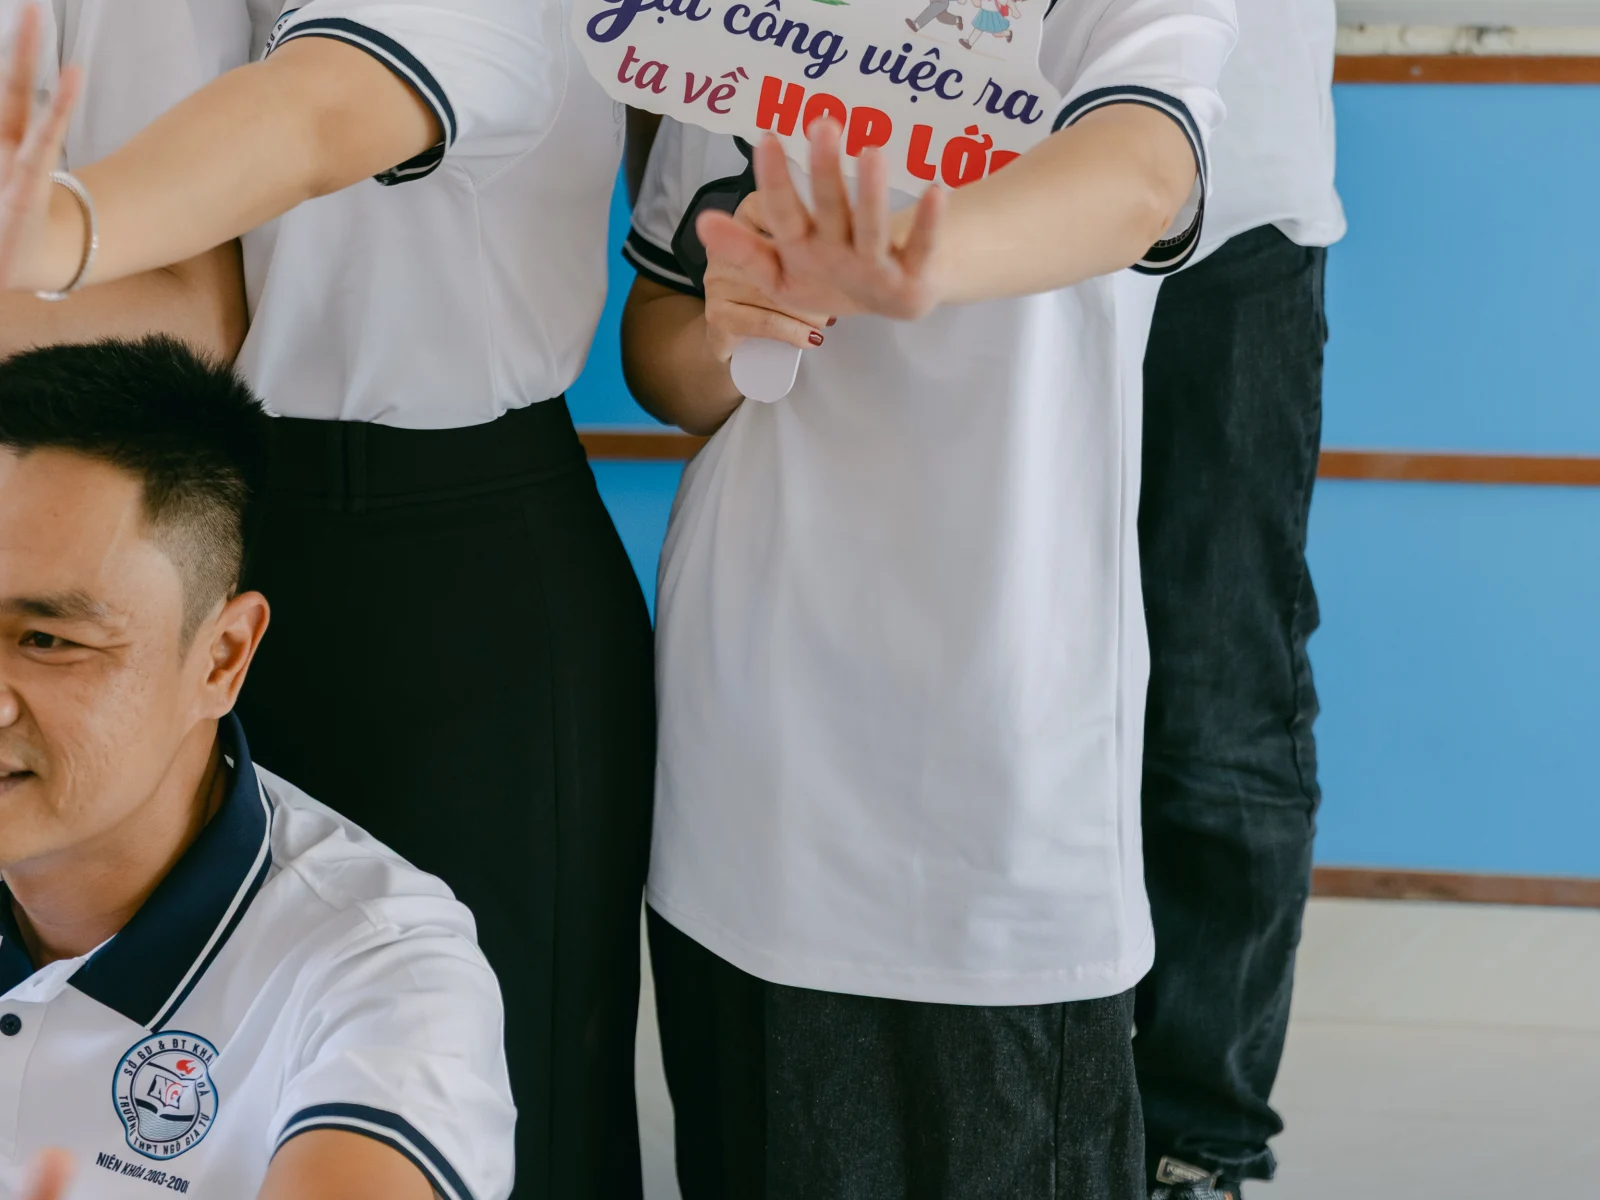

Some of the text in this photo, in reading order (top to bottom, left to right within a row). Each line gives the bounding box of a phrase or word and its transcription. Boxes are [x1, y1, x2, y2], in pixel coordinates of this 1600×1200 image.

[616, 45, 670, 94] ta
[683, 66, 750, 115] về
[860, 42, 964, 104] việc
[972, 77, 1044, 125] ra
[137, 1046, 153, 1059] GD
[158, 1040, 165, 1050] &
[172, 1038, 187, 1050] ĐT
[192, 1043, 214, 1064] KHÁ
[134, 1137, 158, 1154] THPT
[163, 1140, 181, 1155] NGÔ
[185, 1129, 200, 1146] GIA
[96, 1152, 121, 1172] NIÊN
[121, 1162, 146, 1179] KHÓA
